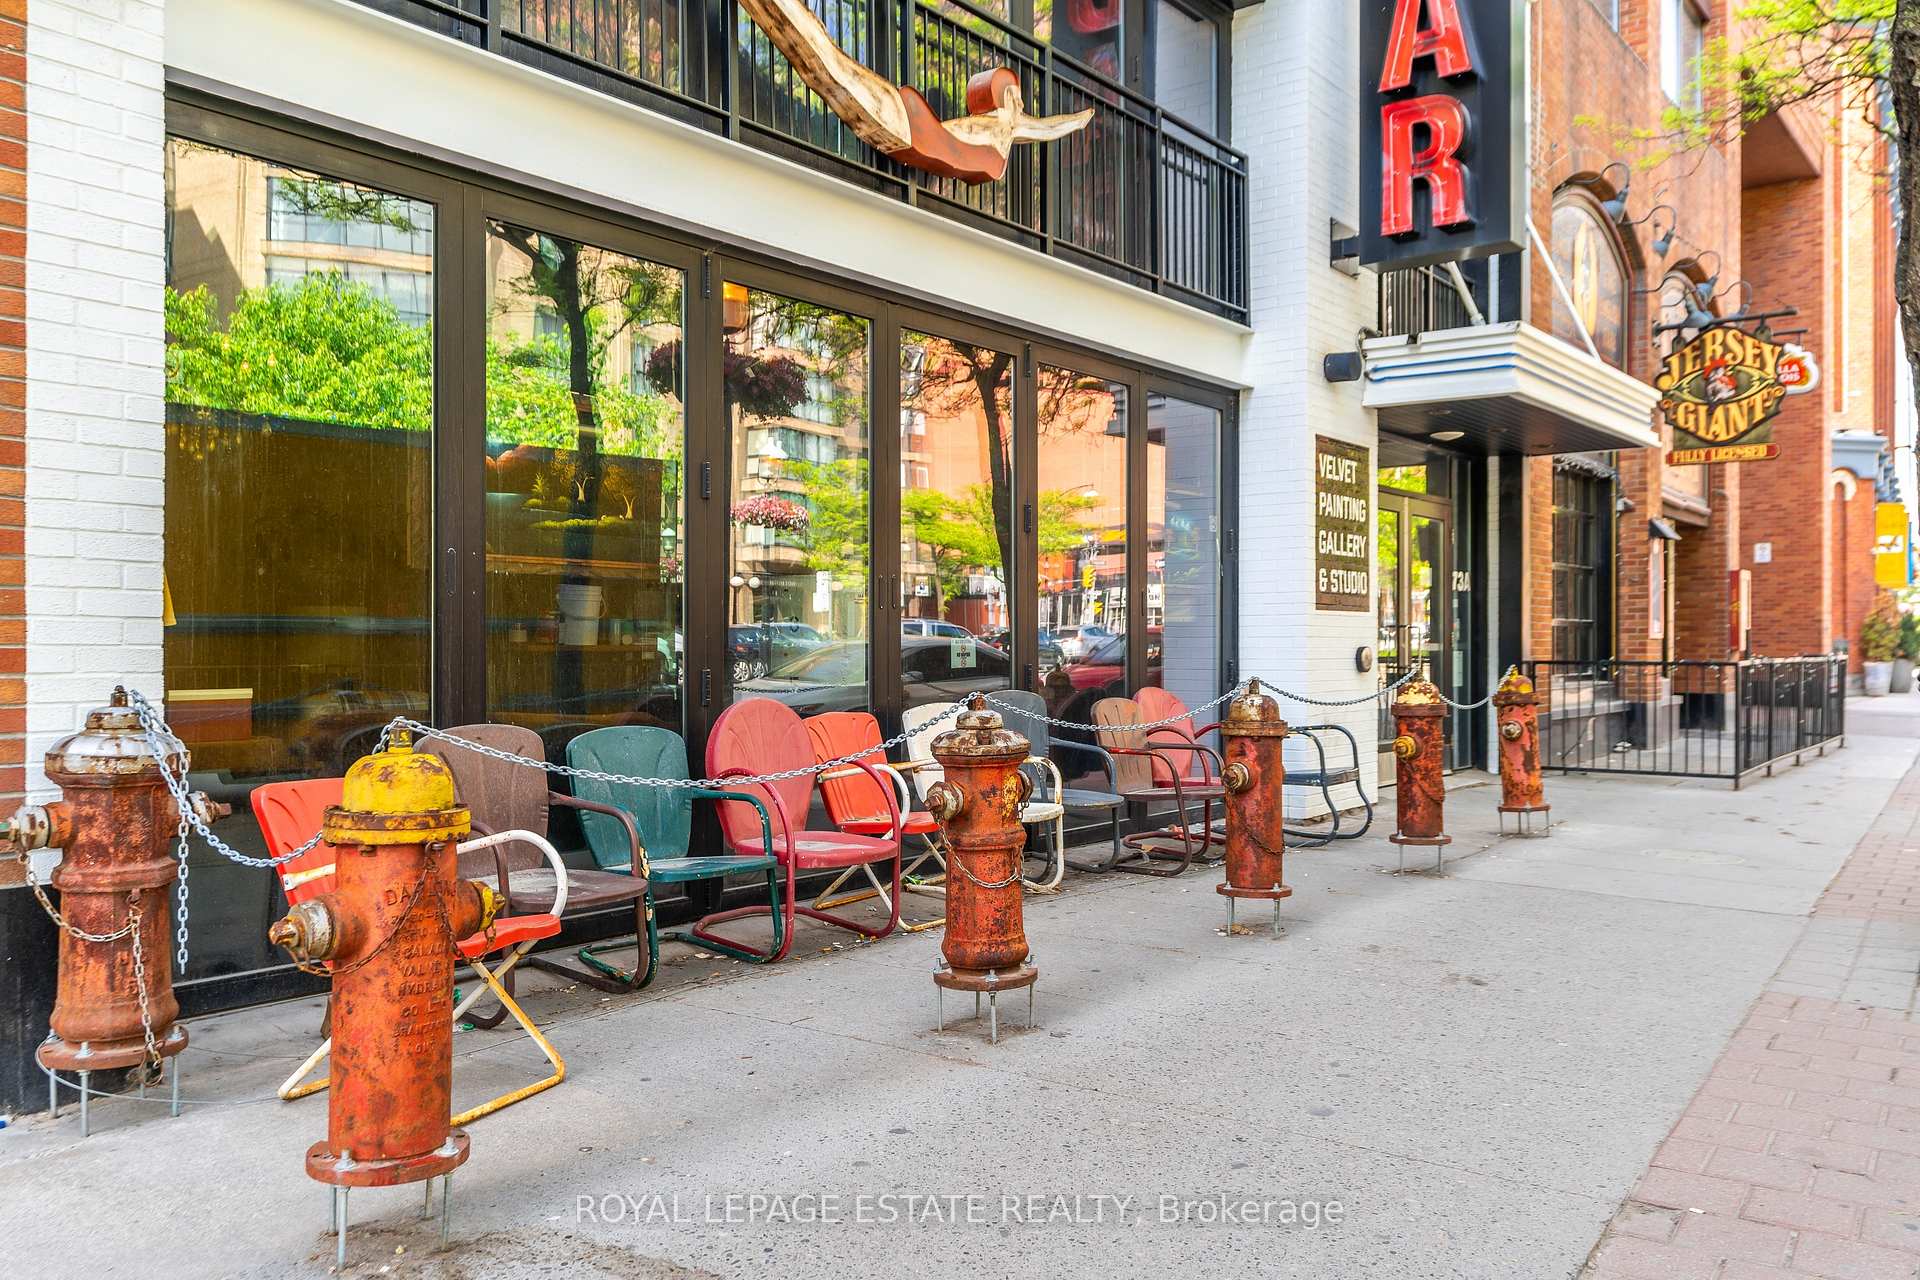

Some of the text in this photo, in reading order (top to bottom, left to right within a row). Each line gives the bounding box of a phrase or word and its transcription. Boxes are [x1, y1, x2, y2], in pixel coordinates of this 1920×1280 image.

[1656, 328, 1783, 391] JERSEY
[1676, 393, 1771, 442] GIANT
[1318, 453, 1358, 485] VELVET
[1318, 491, 1366, 523] PAINTING
[1318, 529, 1368, 559] GALLERY
[1319, 568, 1368, 595] & STUDIO
